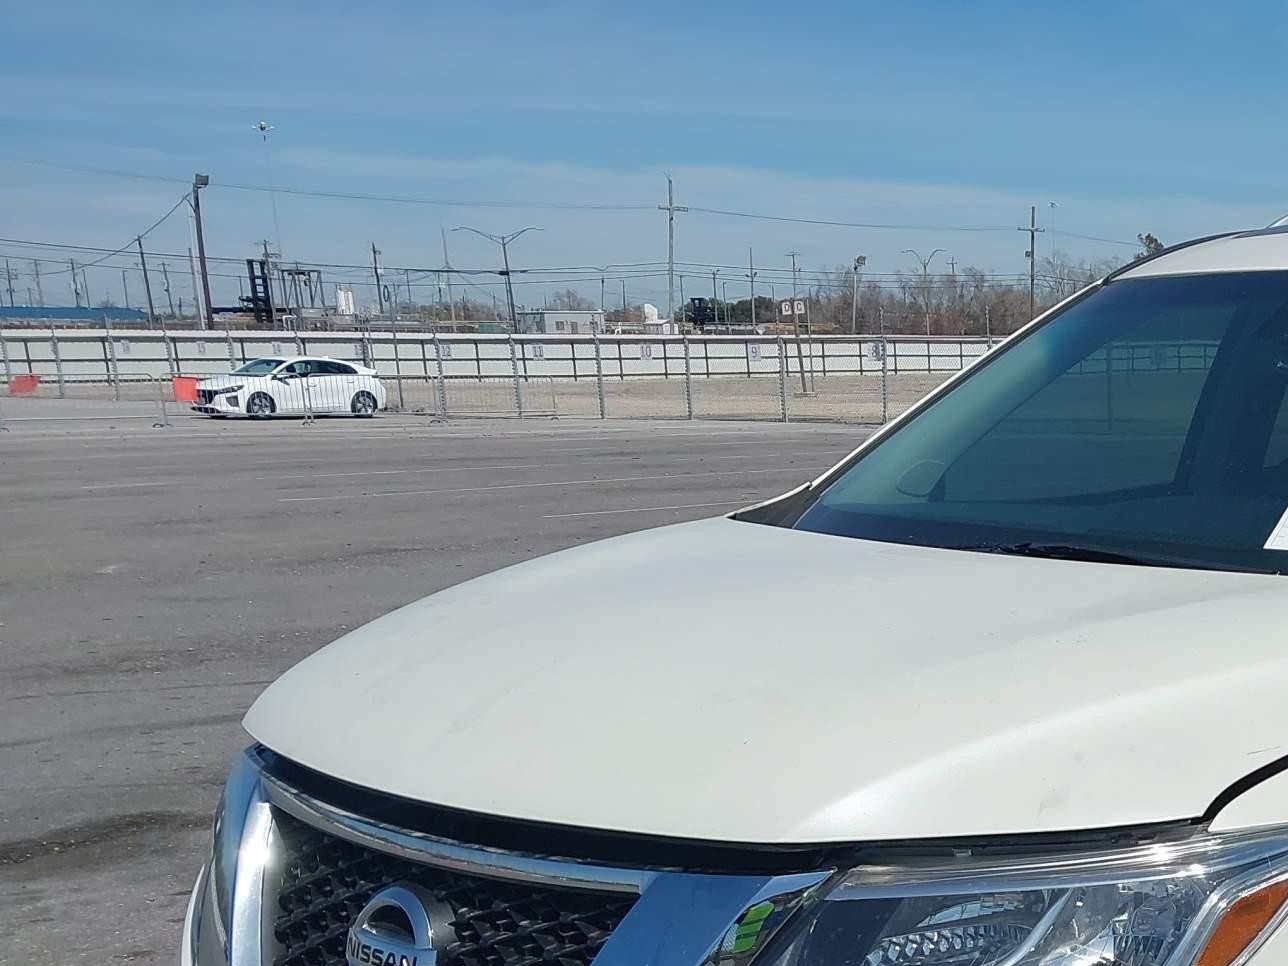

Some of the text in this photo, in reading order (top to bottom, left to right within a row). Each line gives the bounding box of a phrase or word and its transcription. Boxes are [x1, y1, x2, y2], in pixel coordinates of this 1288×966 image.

[784, 303, 790, 312] D
[442, 345, 452, 356] 12
[532, 345, 544, 357] 11
[641, 345, 651, 357] 10
[751, 346, 758, 357] 9
